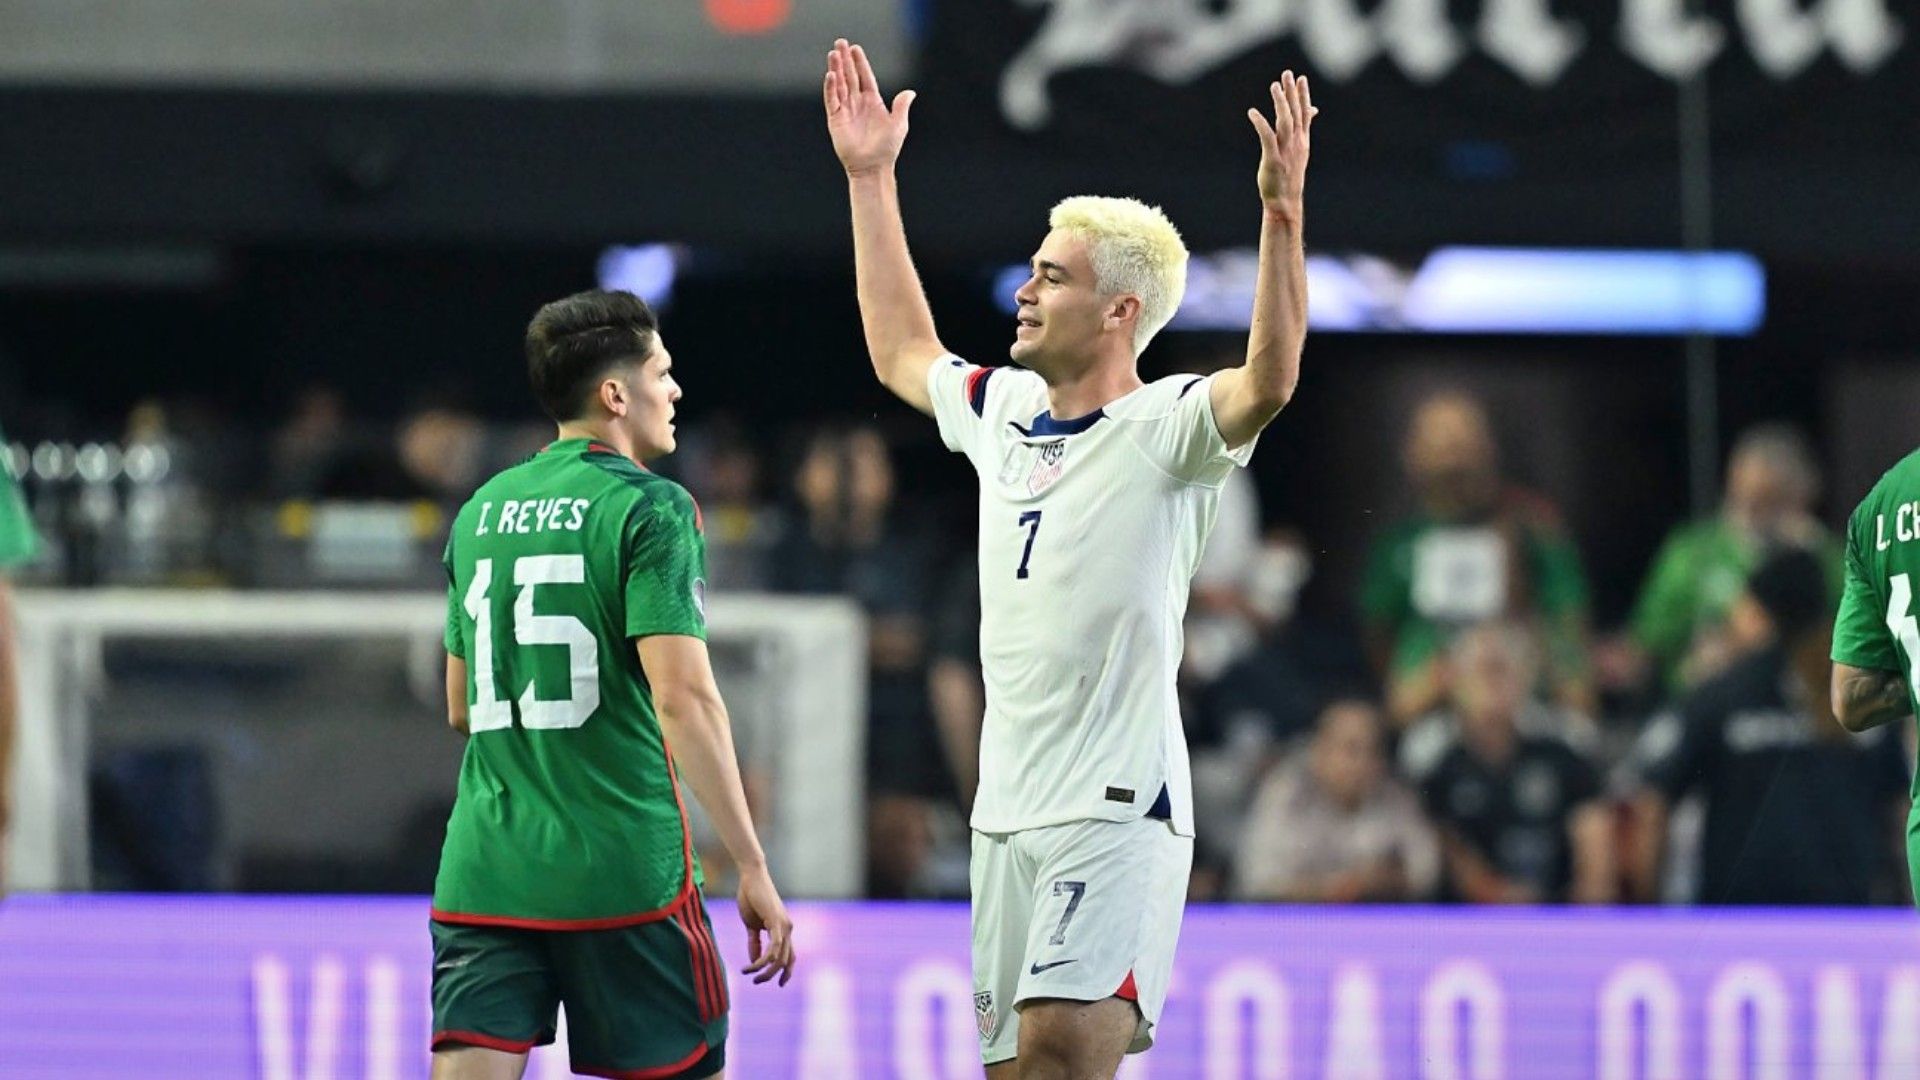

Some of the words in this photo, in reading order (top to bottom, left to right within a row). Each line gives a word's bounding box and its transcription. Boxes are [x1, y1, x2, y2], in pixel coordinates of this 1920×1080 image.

[497, 497, 590, 534] REYES
[1016, 510, 1042, 579] 7
[463, 553, 601, 734] 15
[1049, 881, 1086, 946] 7
